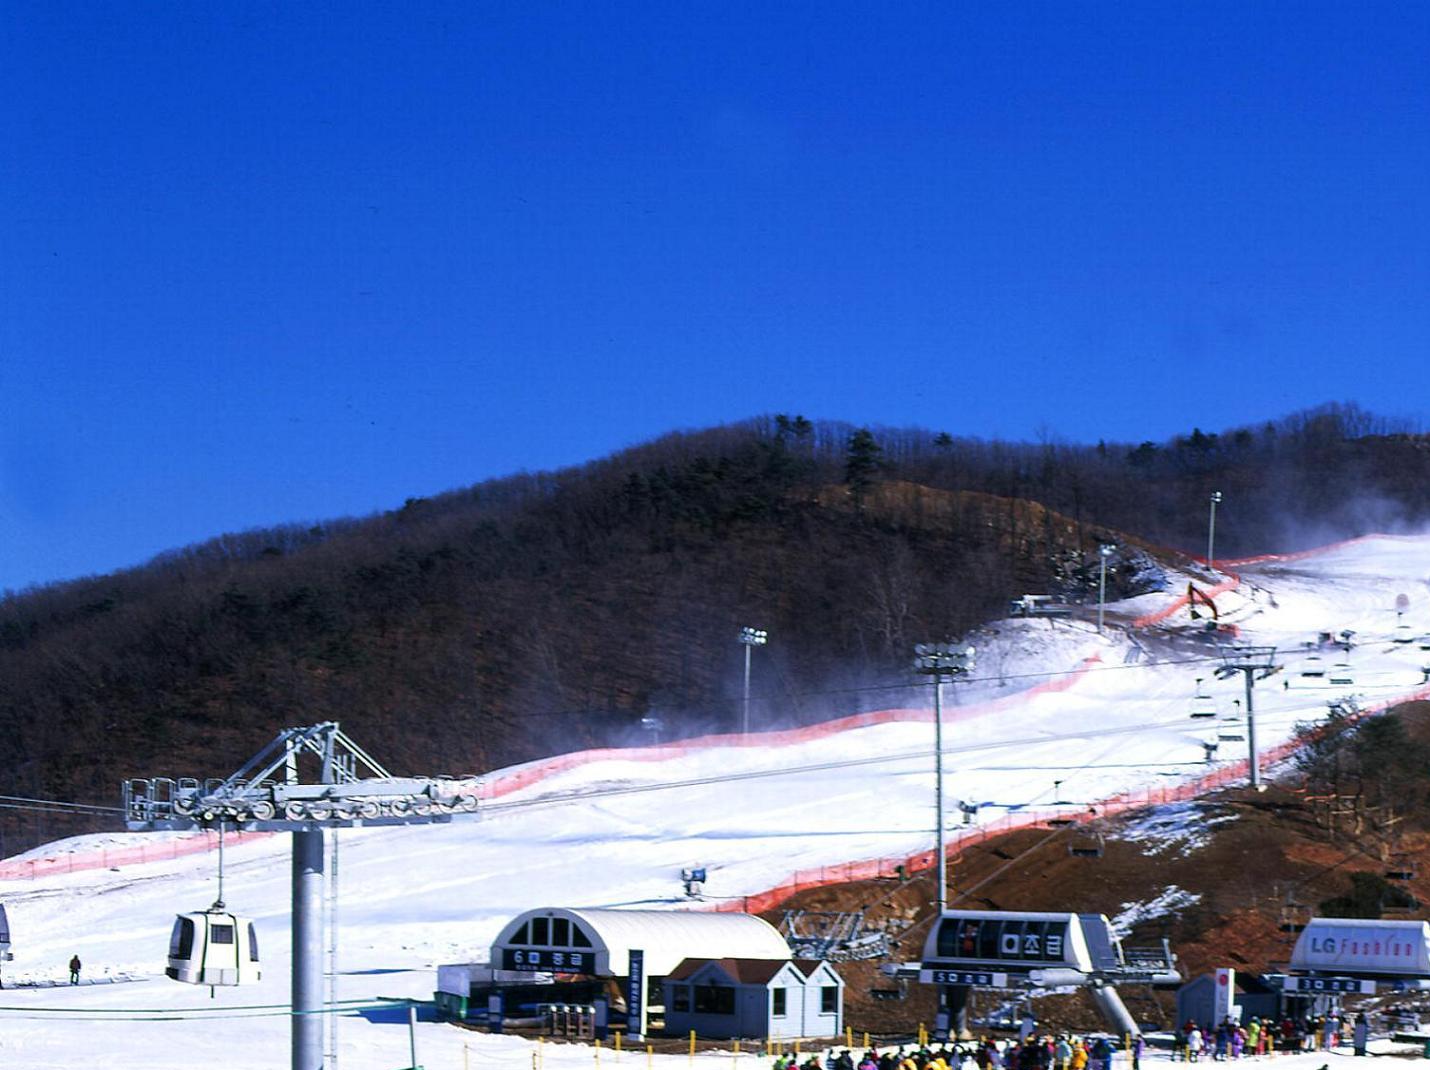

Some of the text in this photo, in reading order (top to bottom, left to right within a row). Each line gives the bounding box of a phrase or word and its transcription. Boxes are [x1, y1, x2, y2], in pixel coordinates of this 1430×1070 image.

[1311, 934, 1412, 958] LG Fashion
[513, 951, 524, 964] 6
